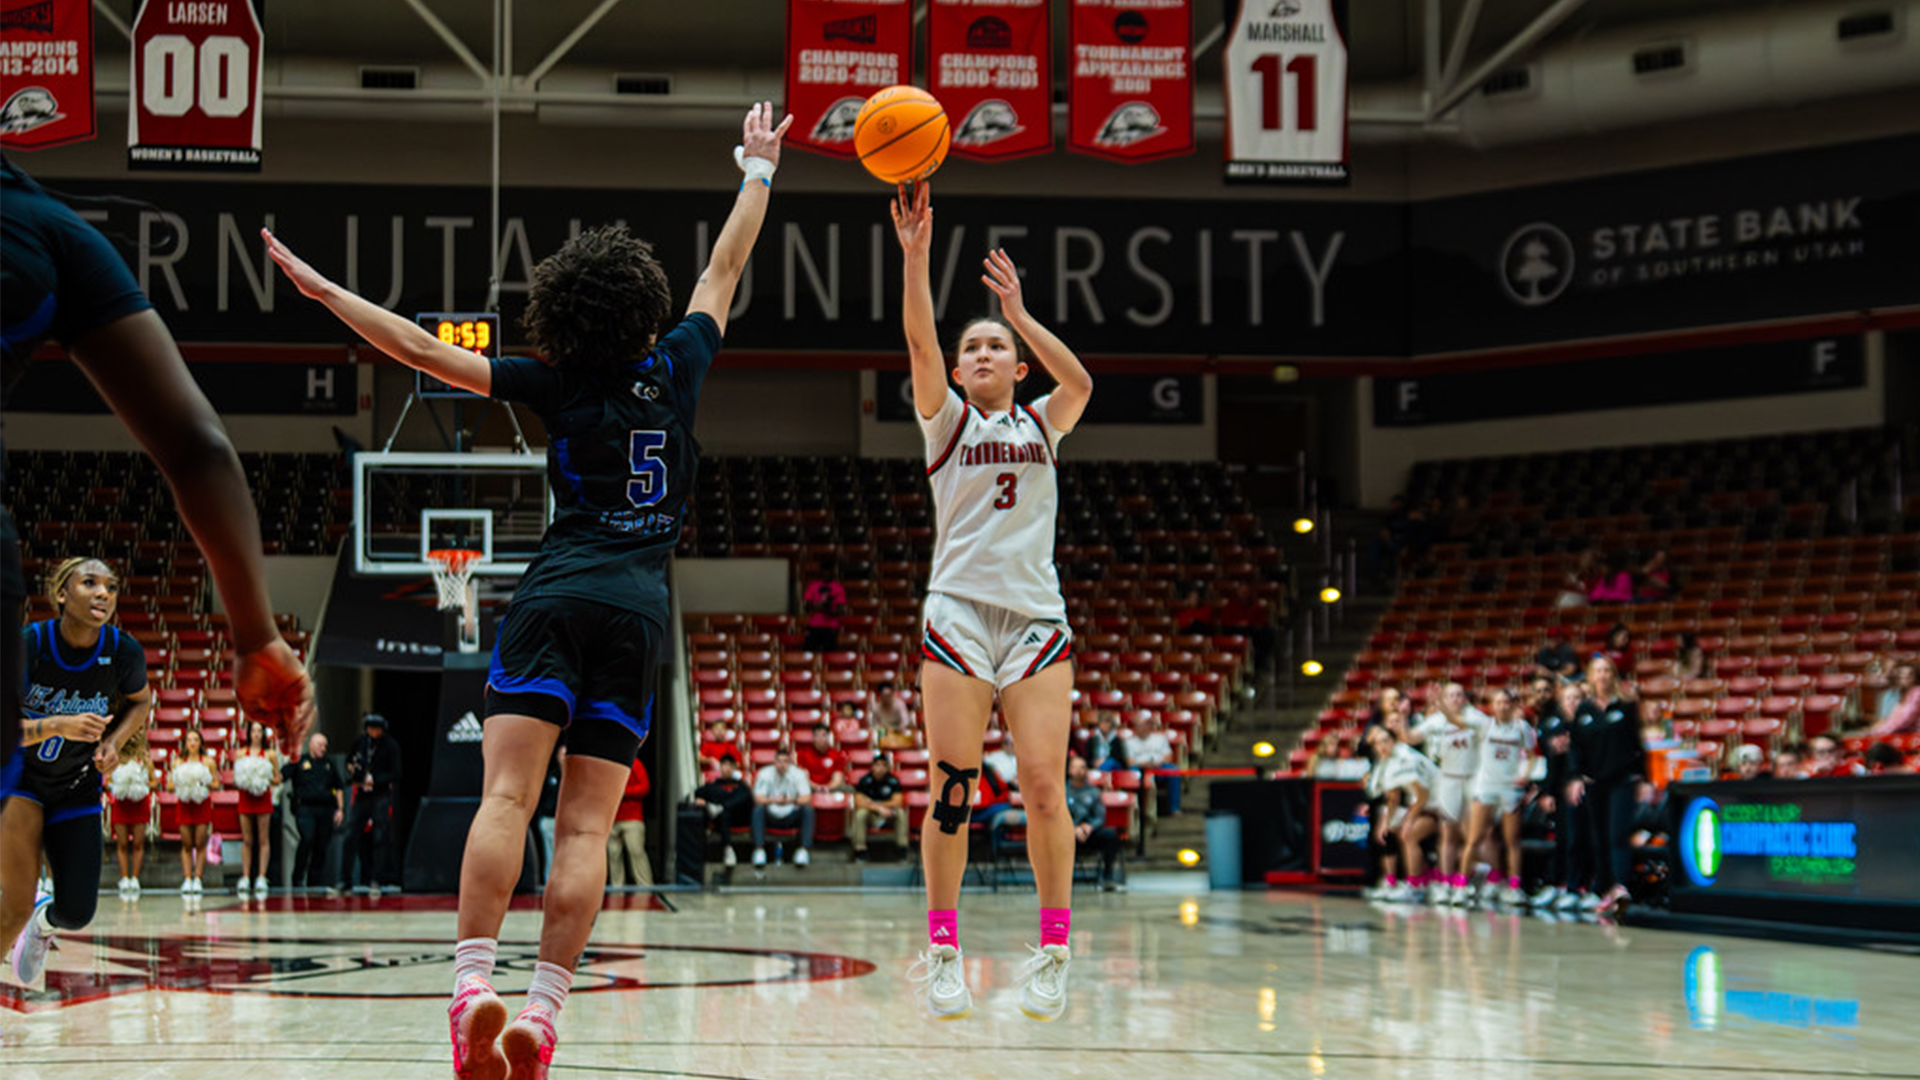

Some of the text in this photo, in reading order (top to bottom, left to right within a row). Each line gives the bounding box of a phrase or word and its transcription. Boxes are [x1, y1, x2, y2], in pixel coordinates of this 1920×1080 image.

[168, 2, 227, 25] LARSEN
[1248, 22, 1325, 42] MARSHALL
[799, 49, 898, 69] CHAMPIONS
[940, 53, 1037, 71] CHAMPIONS
[1077, 44, 1185, 61] TOURNAMENT
[142, 34, 250, 118] 00
[799, 65, 898, 86] 2020-2021
[940, 68, 1038, 90] 2000-2001
[1076, 61, 1186, 79] APPEARANCE
[1250, 53, 1318, 131] 11
[131, 147, 260, 164] WOMEN'S BASKETBALL
[1268, 165, 1346, 179] BASKETBALL
[1592, 196, 1862, 260] STATE BANK
[1593, 238, 1865, 284] OF SOUTHERN UTAH
[437, 320, 491, 350] 8:53
[1813, 341, 1837, 375] F
[306, 367, 335, 400] H
[1152, 377, 1181, 410] G
[1399, 382, 1418, 412] F
[626, 429, 667, 508] 5
[993, 472, 1017, 510] 3
[37, 735, 65, 762] 0
